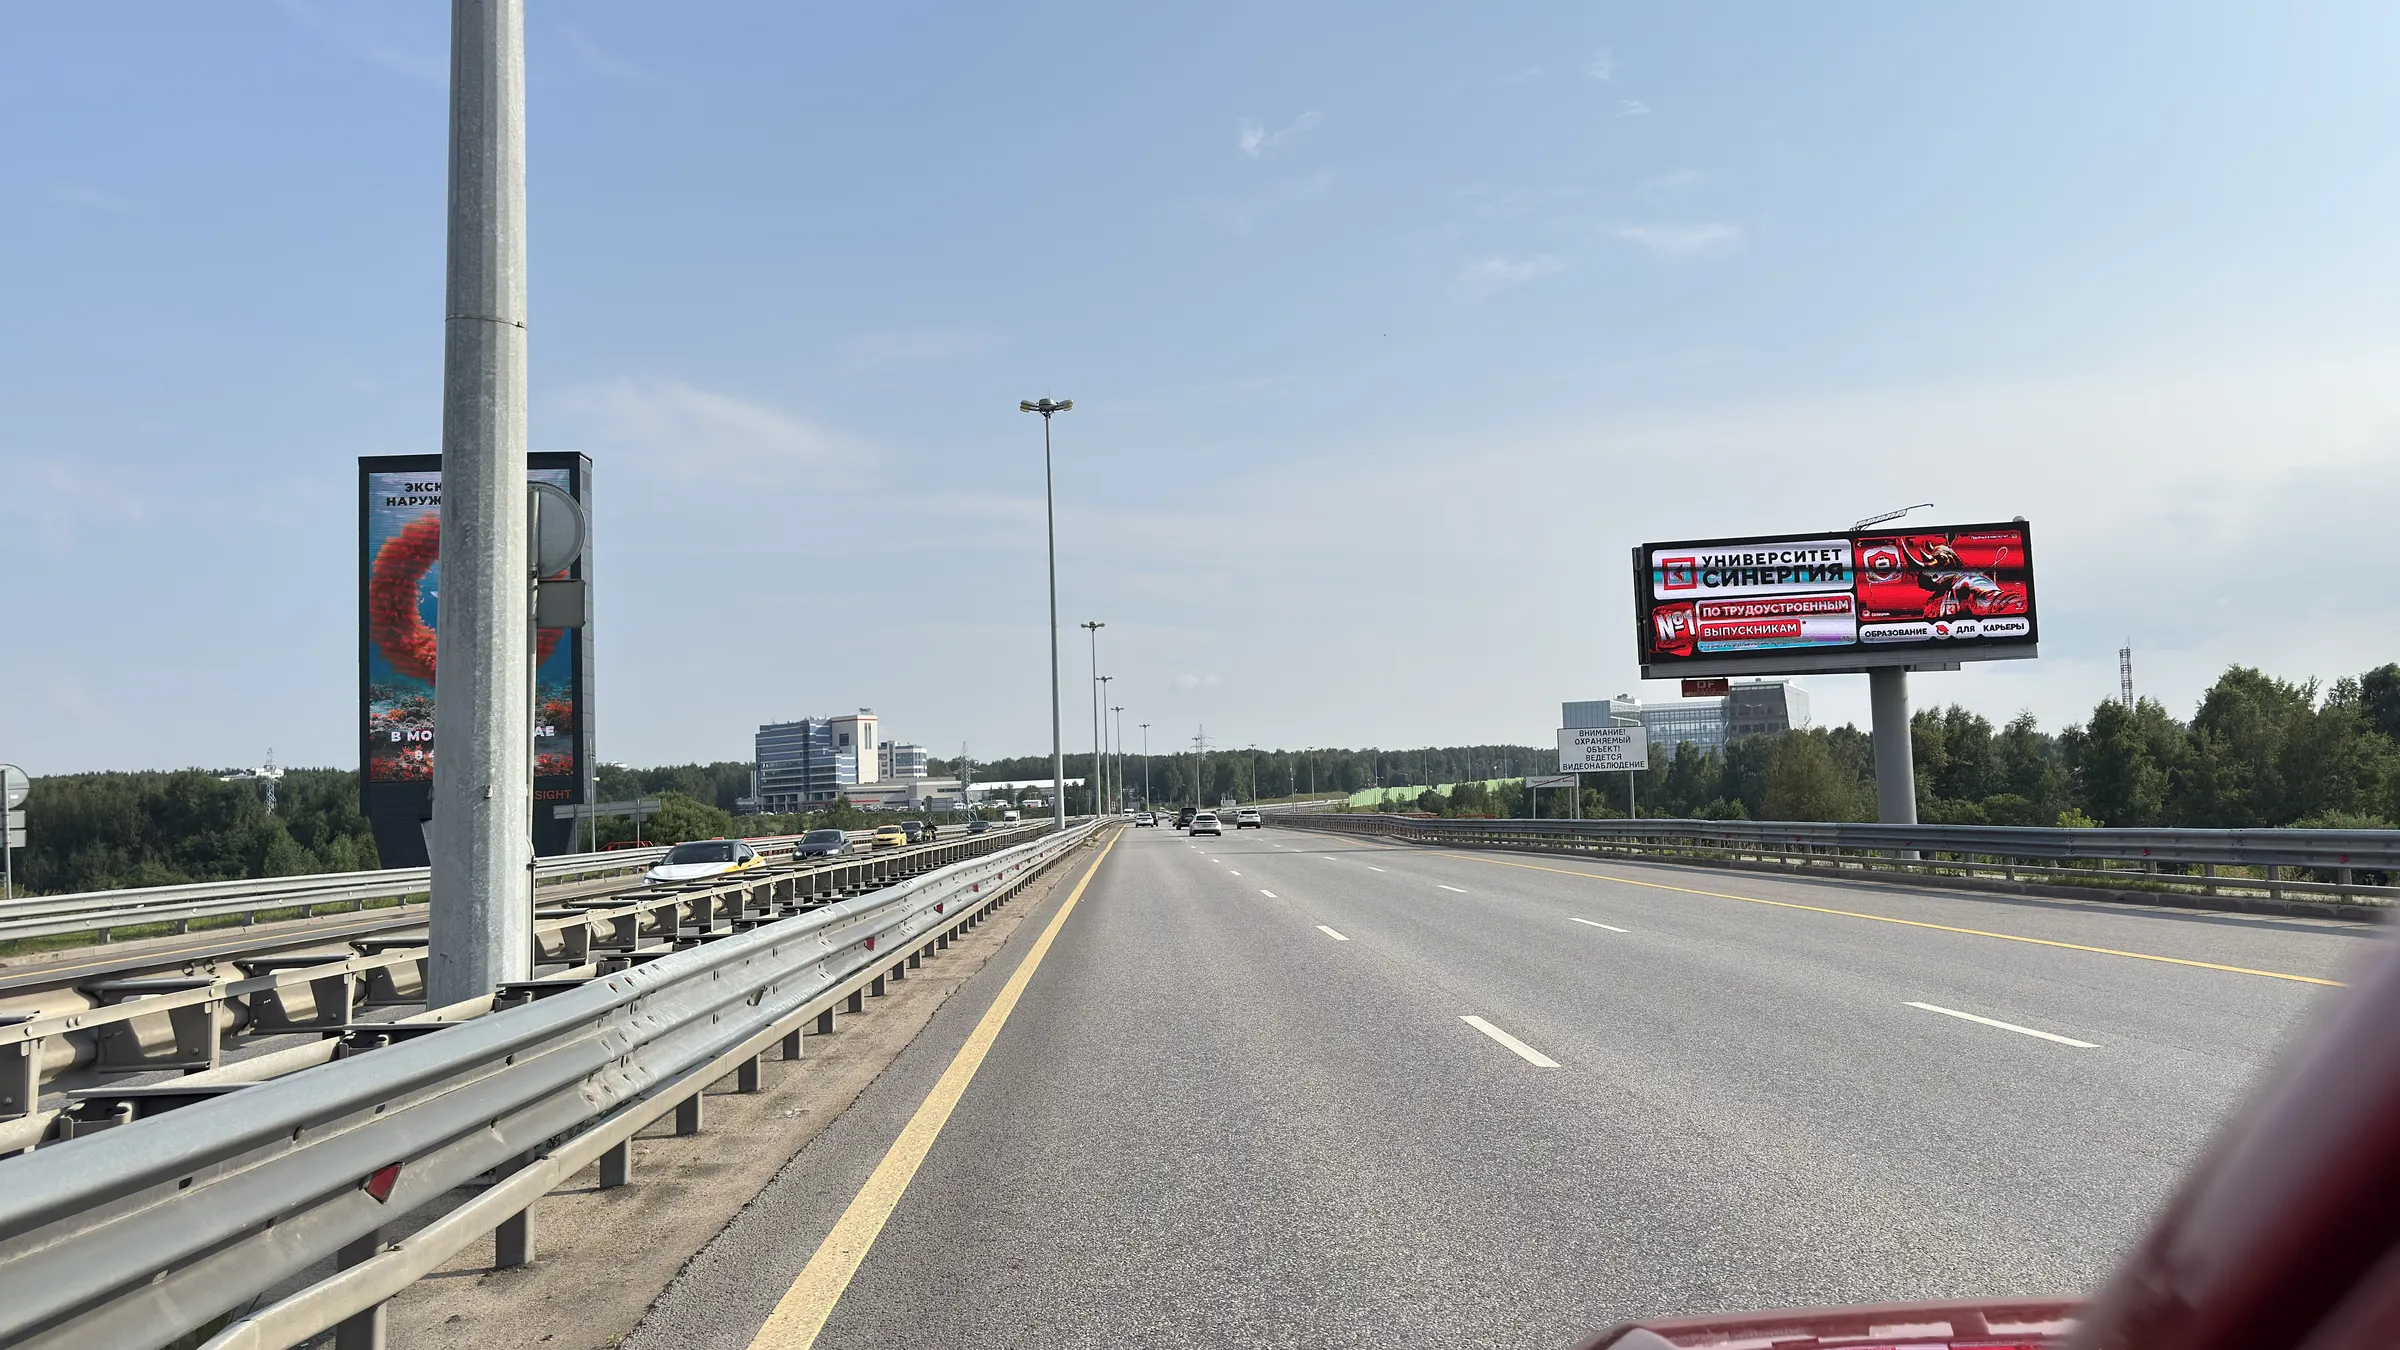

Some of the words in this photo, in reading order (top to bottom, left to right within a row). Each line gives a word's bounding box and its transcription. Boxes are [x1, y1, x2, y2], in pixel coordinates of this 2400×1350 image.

[1701, 549, 1843, 568] УНИВЕРСИТЕТ
[1702, 562, 1845, 589] СИНЕРГИЯ
[1702, 606, 1721, 618] ПО
[1723, 600, 1849, 616] ТРУДОУСТРОЕННЫМ
[1704, 624, 1797, 637] ВЫПУСКНИКАМ
[1864, 627, 1928, 638] ОБРАЗОВАНИЕ
[1955, 625, 1976, 635] ДЛЯ
[1982, 622, 2025, 633] КАРЬЕРЫ
[391, 731, 401, 742] В
[407, 730, 435, 742] МО
[1579, 728, 1626, 737] ВНИМАНИЕ!
[1574, 735, 1632, 745] ОХРАНЯЕМЫЙ
[1586, 745, 1621, 753] ОБЪЕКТ!
[1585, 753, 1622, 762] ВЕДЕТСЯ
[1562, 760, 1645, 771] ВИДЕОНАБЛЮДЕНИЕ
